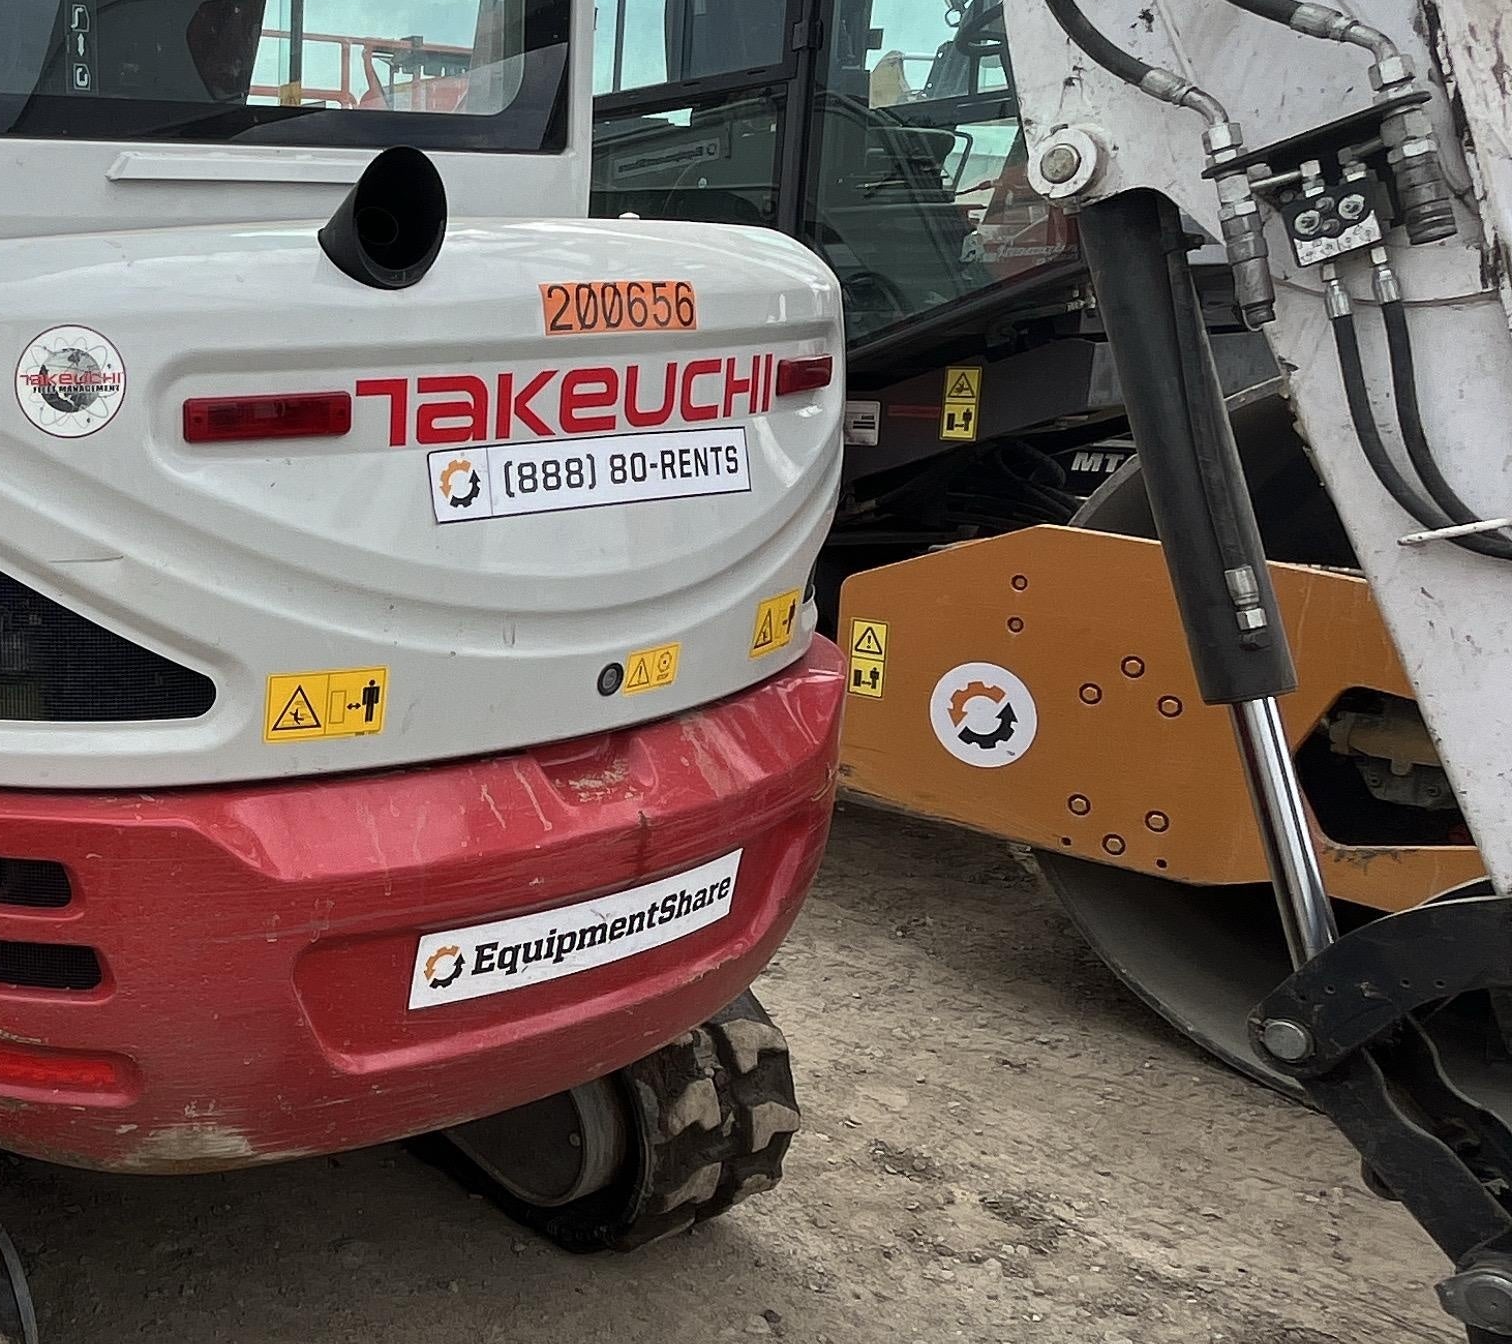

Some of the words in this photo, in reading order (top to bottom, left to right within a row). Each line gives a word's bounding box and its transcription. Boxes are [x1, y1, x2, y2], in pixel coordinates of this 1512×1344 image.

[546, 281, 695, 331] 200656
[19, 371, 121, 386] TAKEUCHI
[356, 353, 774, 447] TAKEUCHI
[504, 456, 598, 498] (888)
[610, 445, 738, 485] 80-RENTS
[471, 875, 732, 976] EquipmentShare
